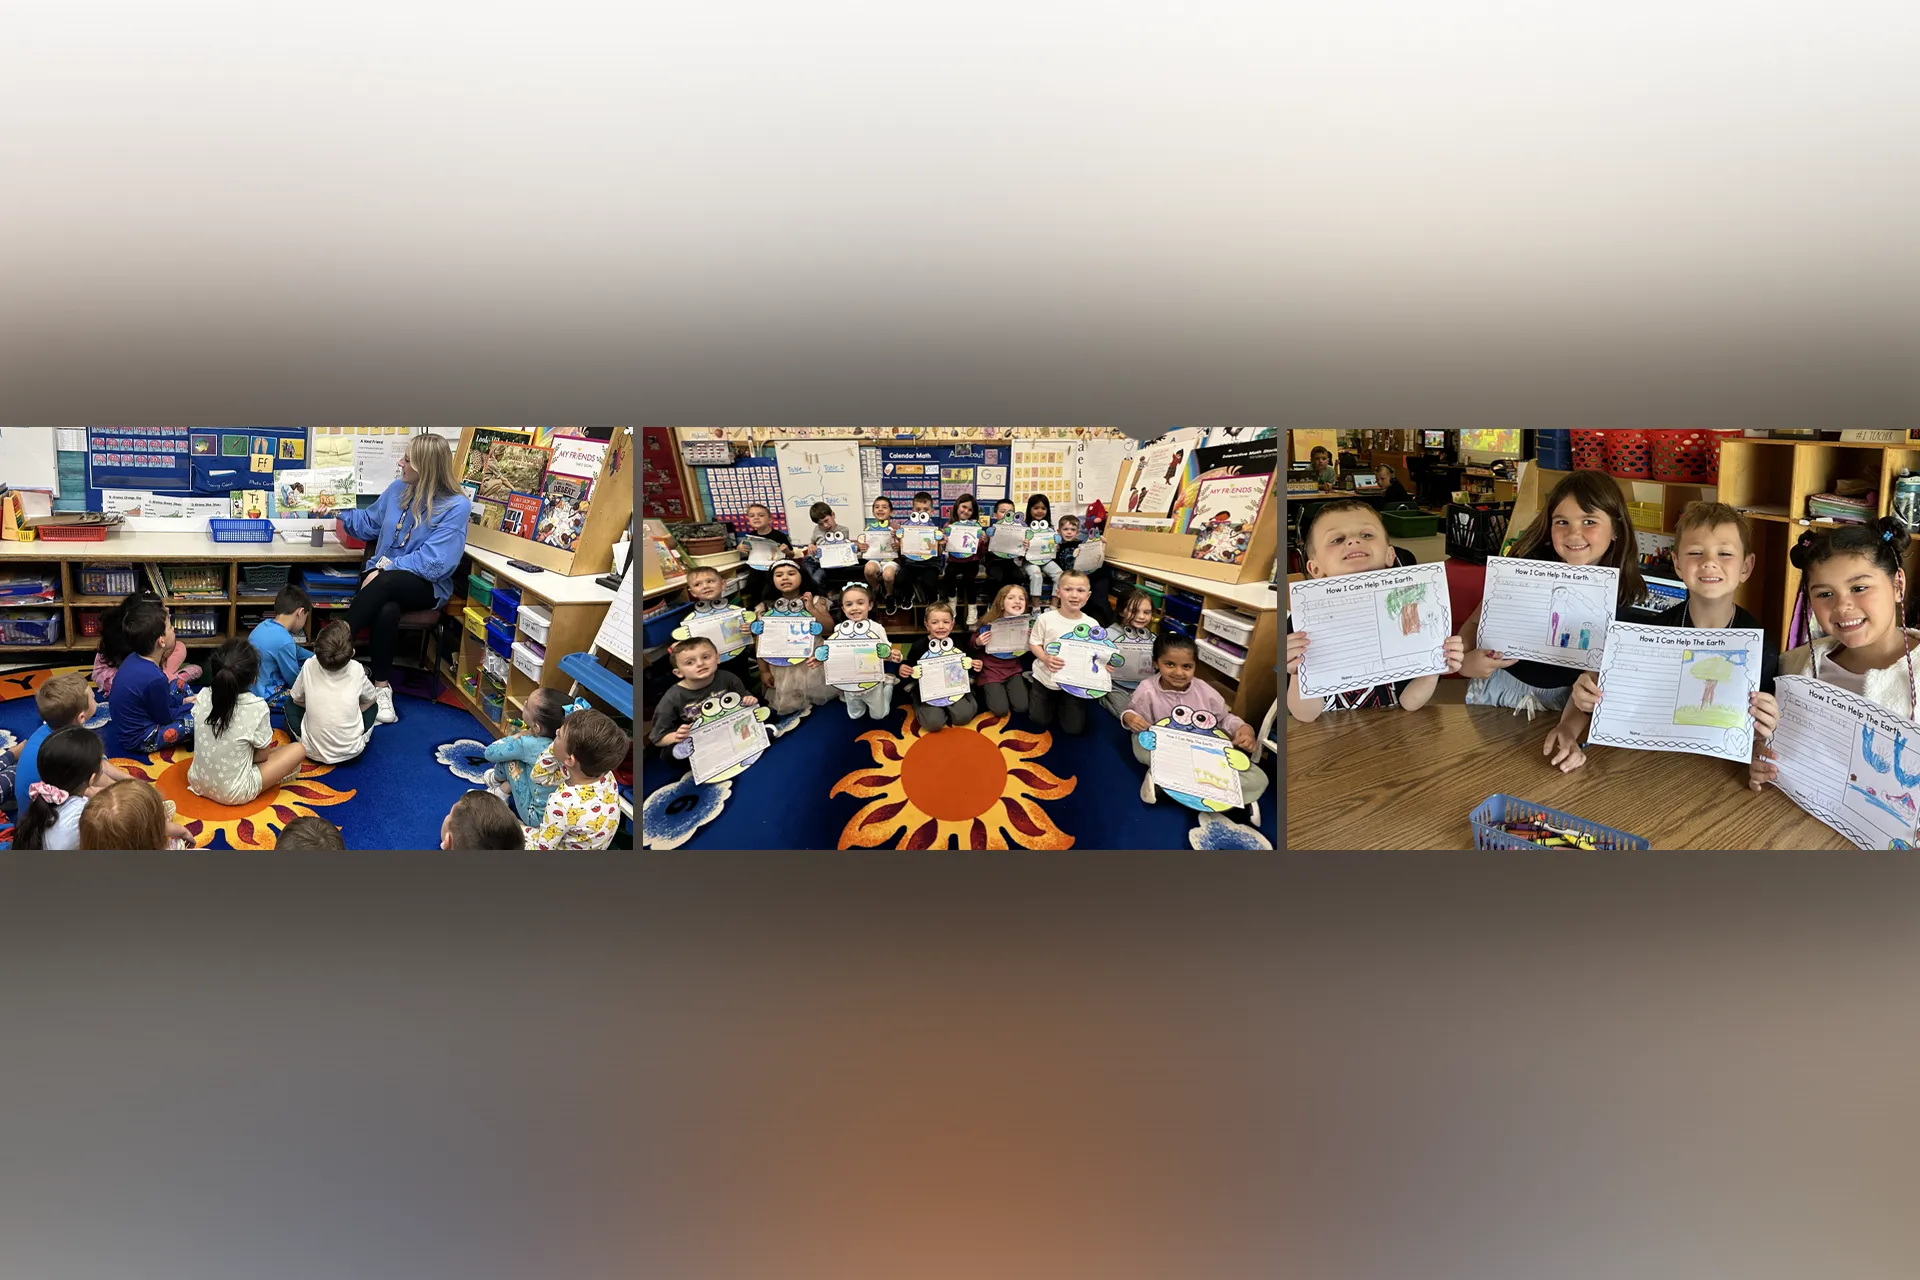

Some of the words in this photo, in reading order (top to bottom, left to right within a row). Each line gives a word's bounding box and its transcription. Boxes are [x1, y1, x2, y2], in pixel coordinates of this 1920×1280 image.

[1856, 431, 1866, 440] #1
[1869, 431, 1893, 440] TEACHER
[981, 469, 991, 480] G
[1078, 469, 1082, 478] i
[1676, 638, 1691, 647] Help
[1809, 689, 1824, 701] How
[1832, 698, 1846, 710] Can
[1848, 704, 1863, 719] Help
[1866, 714, 1878, 726] The
[1880, 720, 1902, 737] Earth
